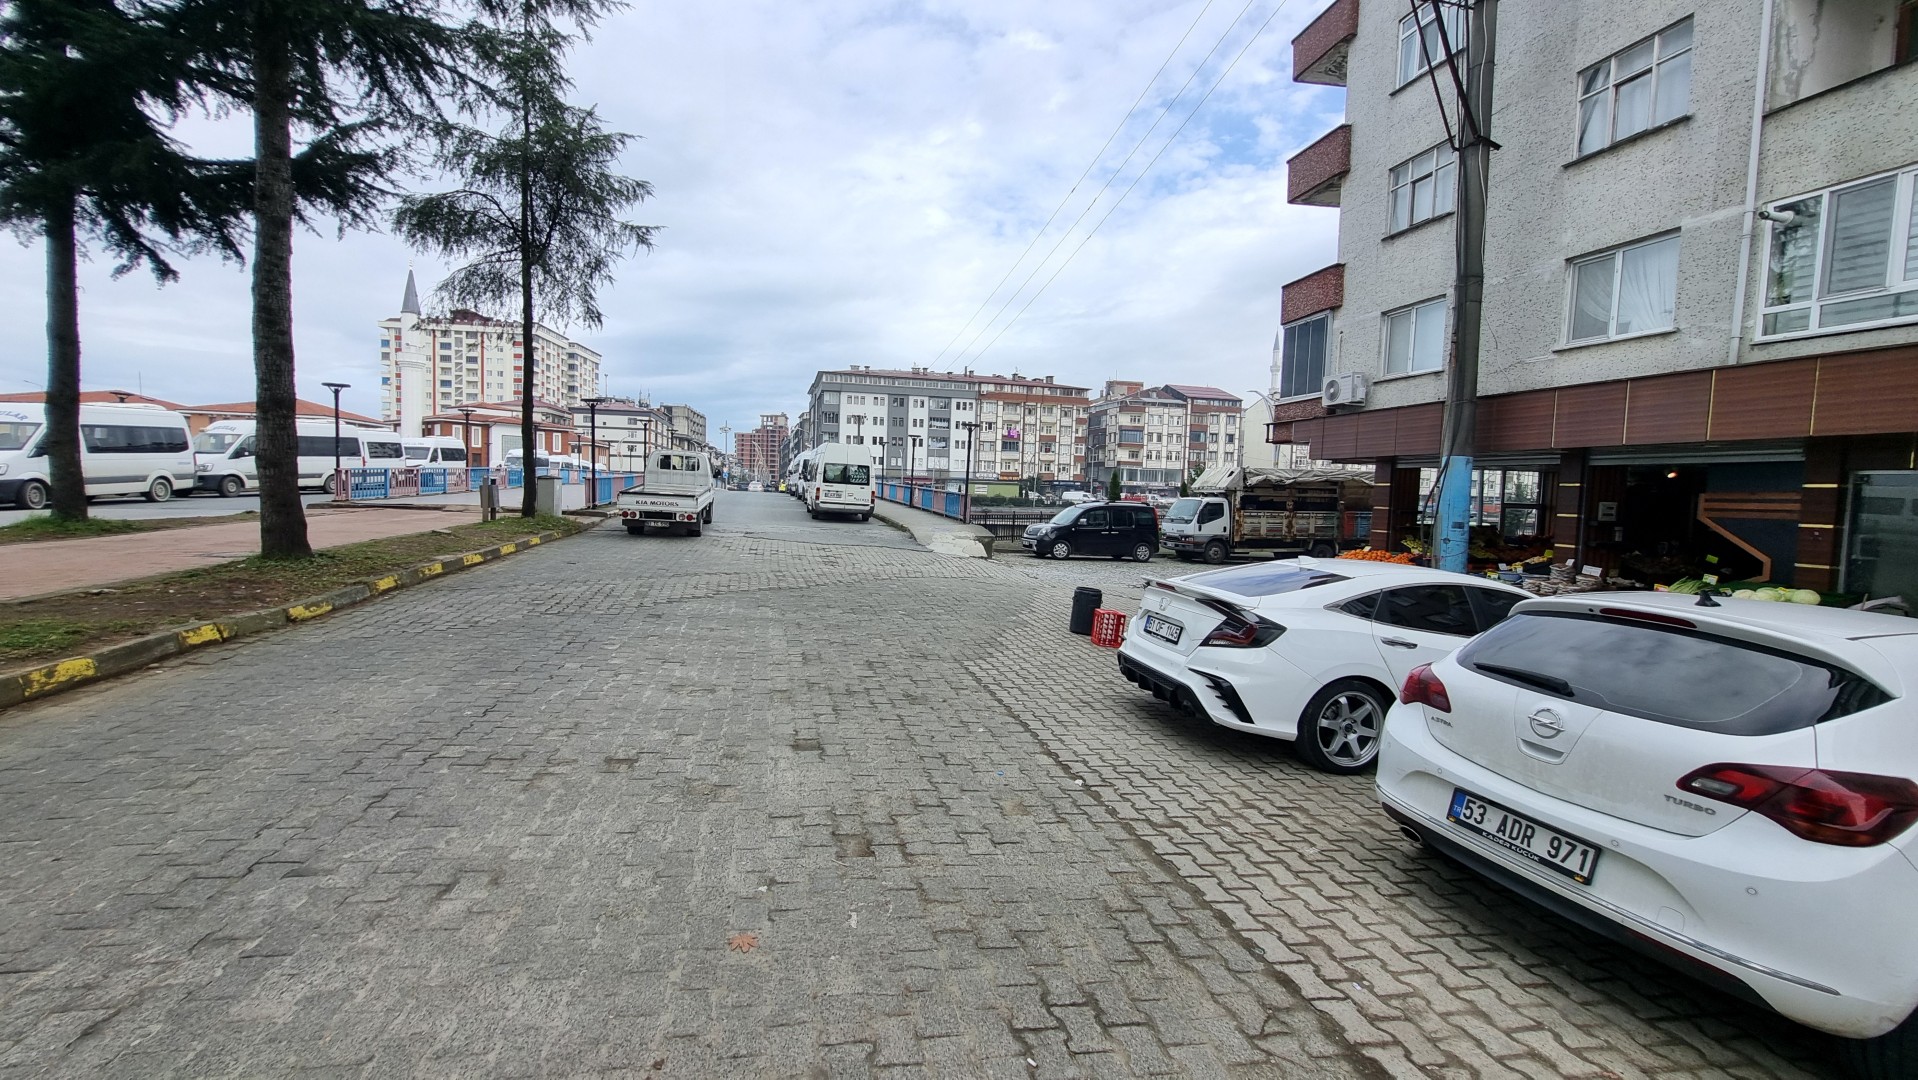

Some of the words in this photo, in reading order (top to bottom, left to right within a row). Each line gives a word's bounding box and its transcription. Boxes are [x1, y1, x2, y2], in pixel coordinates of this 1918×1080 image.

[1453, 805, 1462, 814] TR
[1663, 794, 1717, 816] TURBO
[1463, 799, 1487, 825] 53
[1495, 814, 1536, 848] ADR
[1546, 835, 1590, 873] 971
[1481, 831, 1510, 848] KADER
